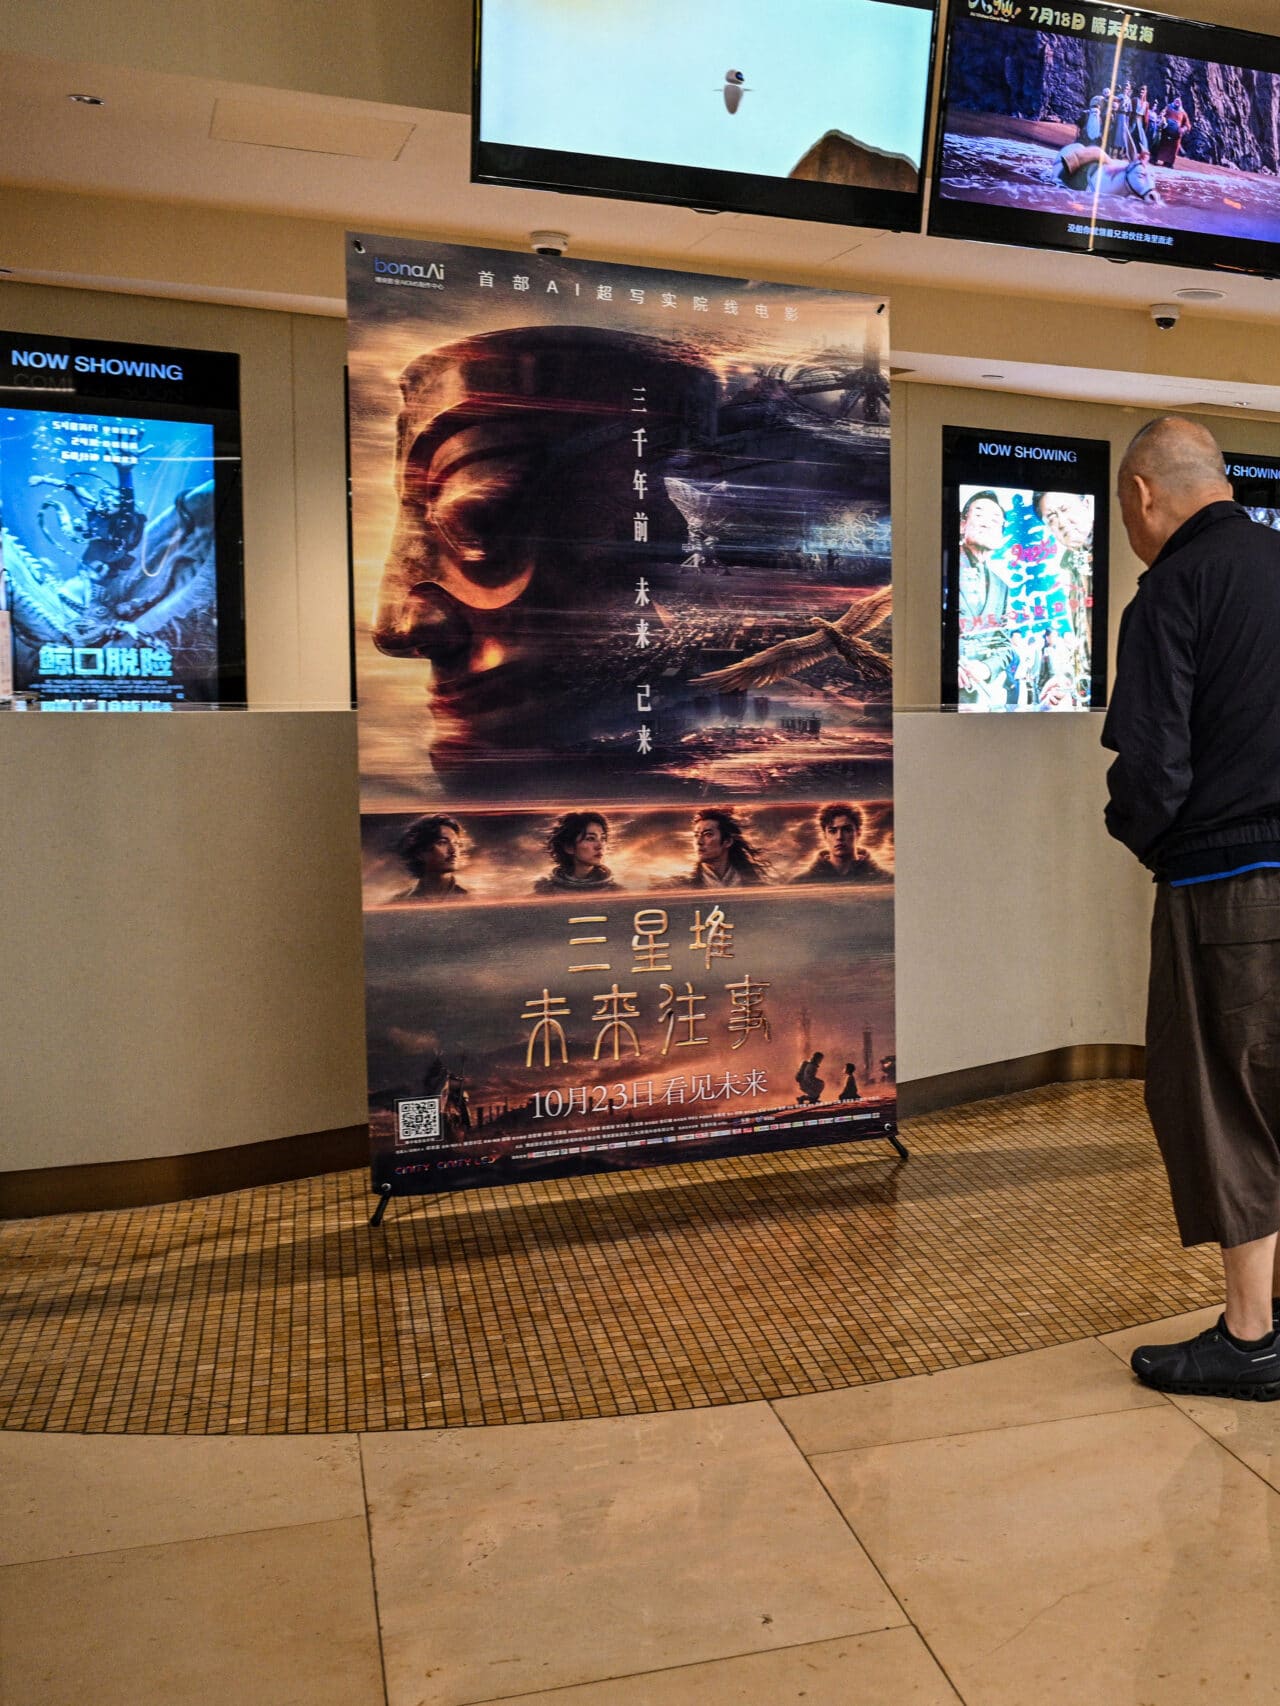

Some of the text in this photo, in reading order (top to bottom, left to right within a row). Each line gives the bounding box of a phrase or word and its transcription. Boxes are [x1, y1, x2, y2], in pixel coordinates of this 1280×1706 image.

[1028, 6, 1087, 31] 7月18日
[11, 349, 184, 381] NOW SHOWING
[631, 386, 649, 543] 三千年前
[978, 442, 1078, 463] NOW SHOWING
[38, 643, 174, 677] 鲸口脱险
[567, 904, 736, 974] 三星堆
[520, 974, 772, 1068] 未来往事
